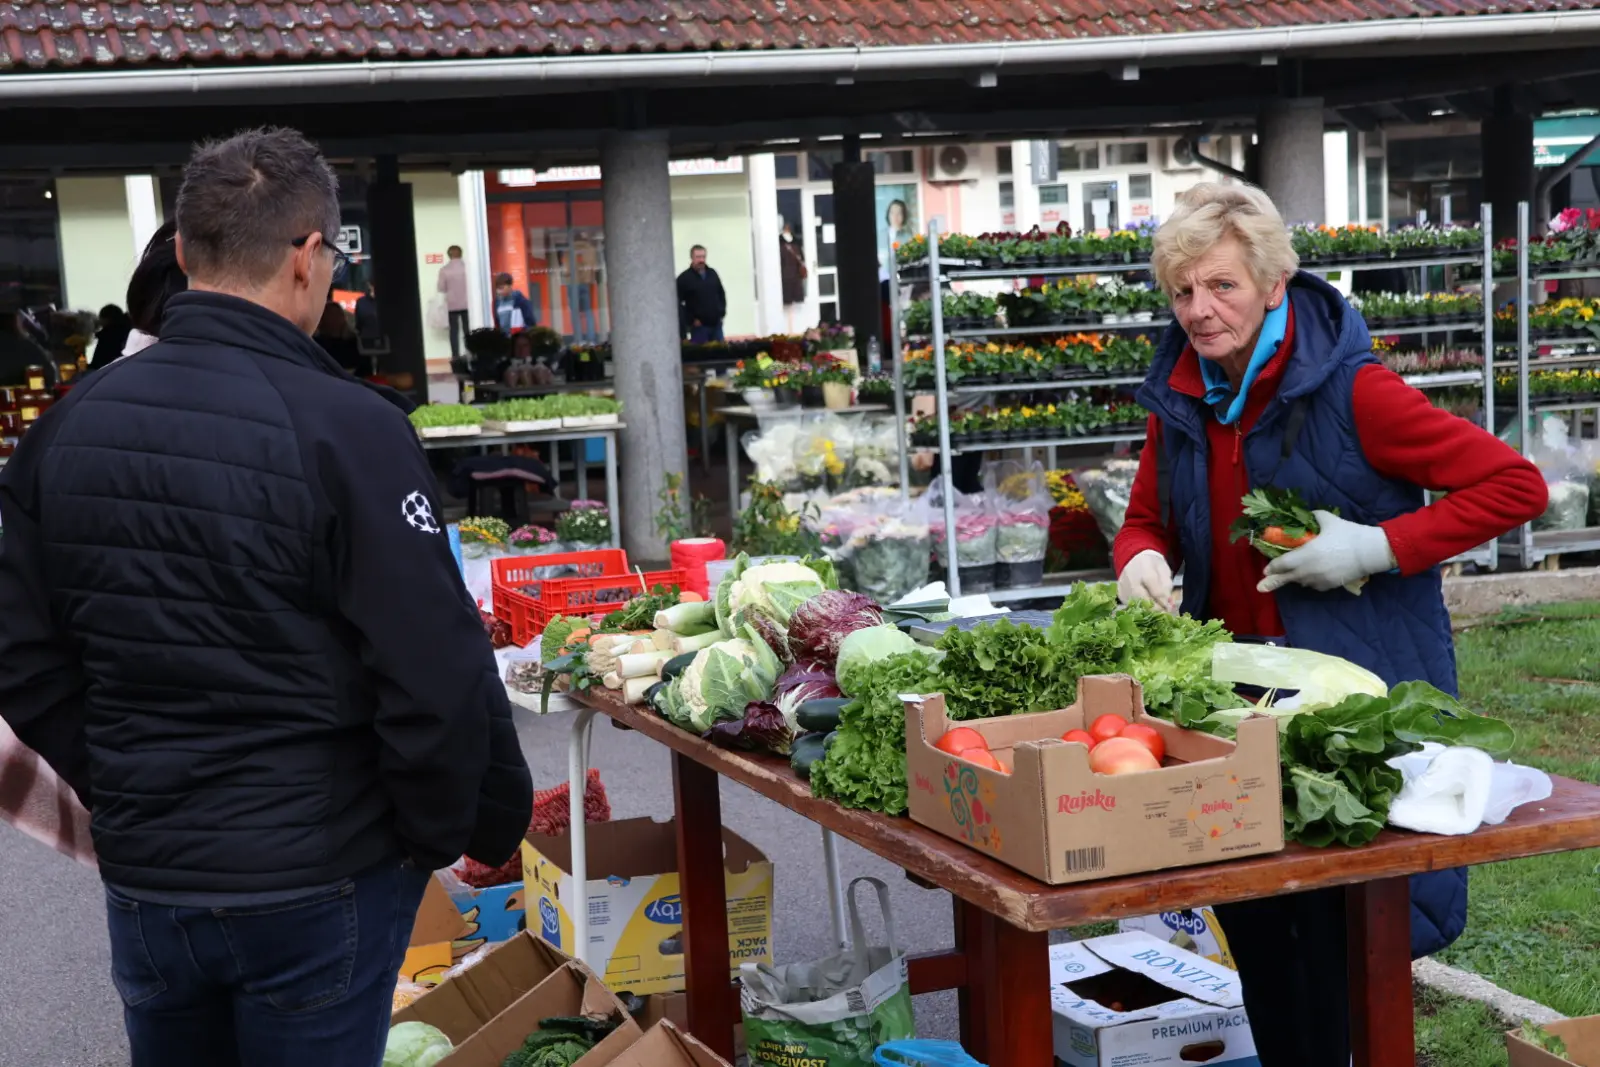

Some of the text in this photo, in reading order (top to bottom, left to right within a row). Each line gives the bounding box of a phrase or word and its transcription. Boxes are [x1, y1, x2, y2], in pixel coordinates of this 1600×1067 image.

[1057, 788, 1116, 814] Rajska
[1200, 799, 1233, 815] Rajska
[649, 899, 682, 922] rby
[736, 936, 767, 948] PACK
[729, 946, 767, 959] VACUU
[1131, 948, 1232, 993] BONITA
[1152, 1021, 1213, 1039] PREMIUM
